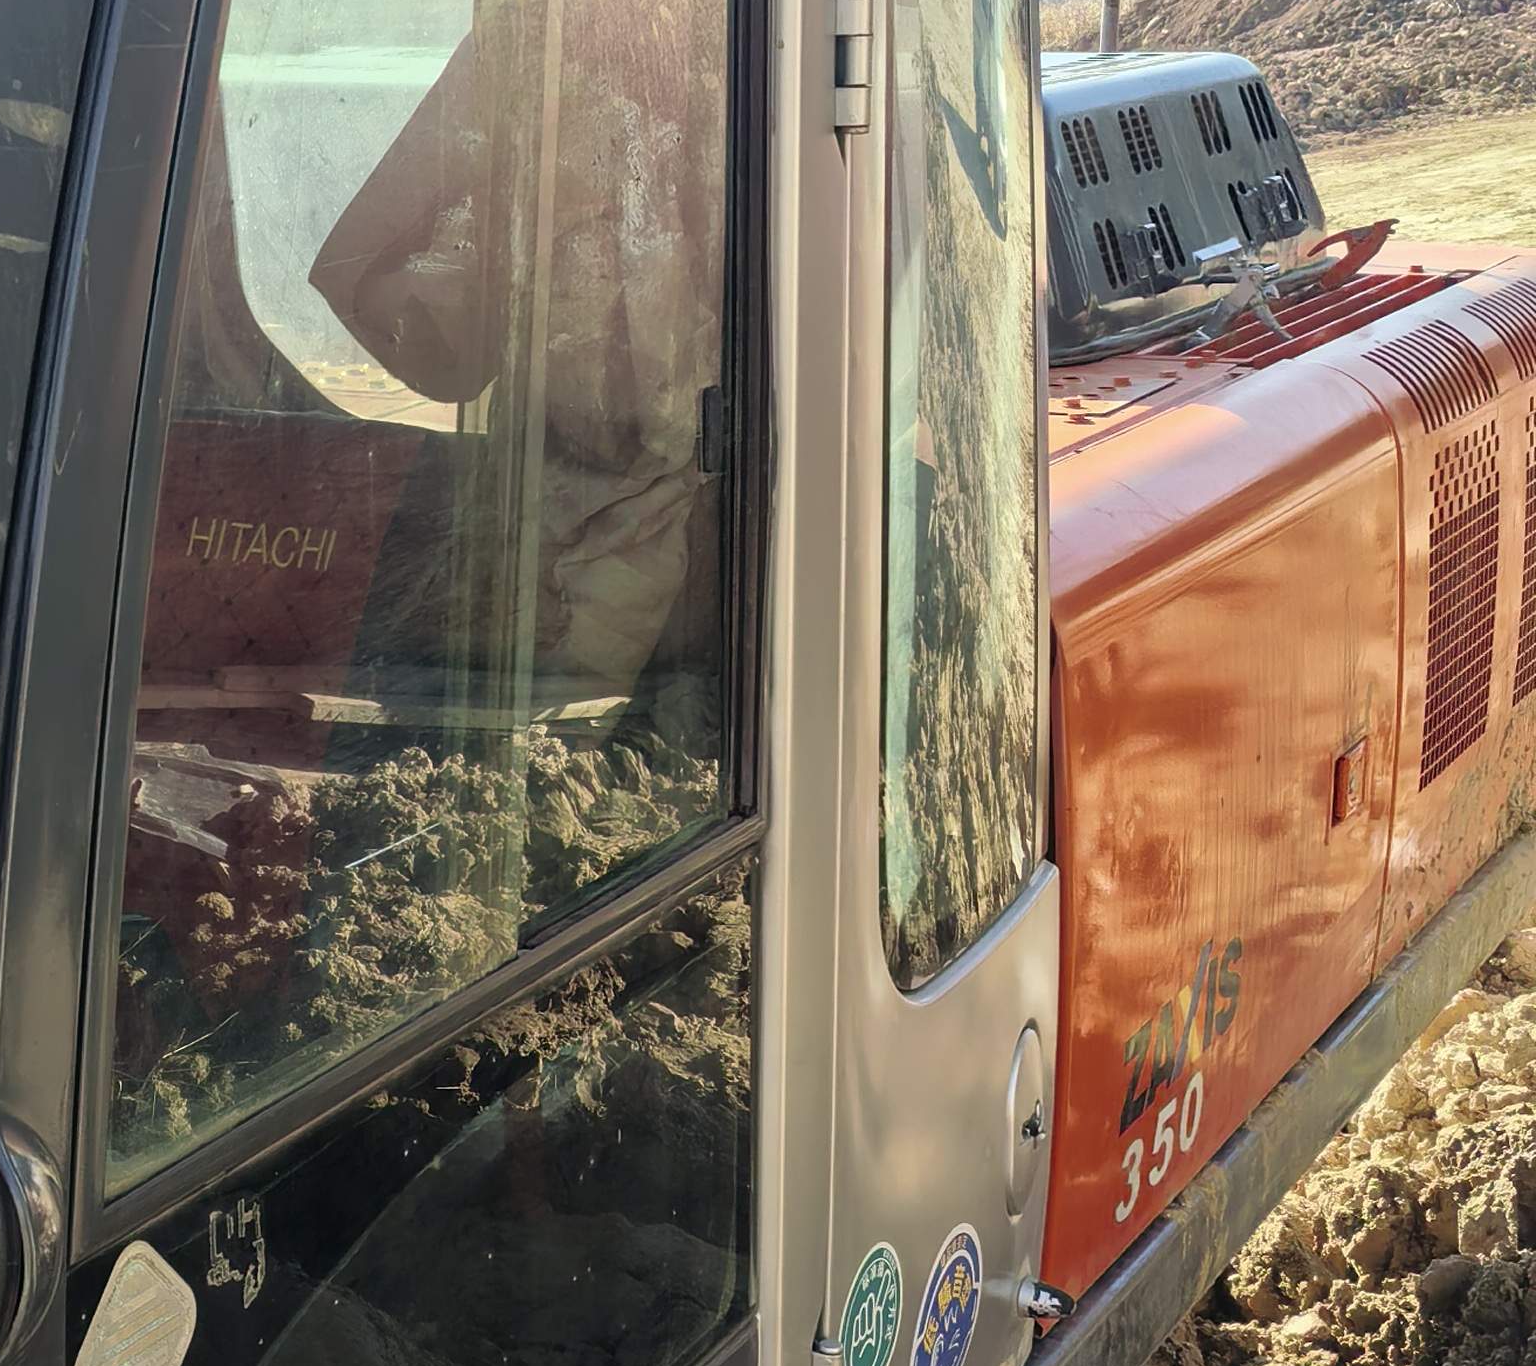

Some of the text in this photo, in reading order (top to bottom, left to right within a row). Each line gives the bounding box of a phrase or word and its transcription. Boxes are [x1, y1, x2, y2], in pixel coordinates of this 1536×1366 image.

[185, 516, 337, 572] HITACHI
[1118, 935, 1243, 1137] ZAXIS
[1114, 1070, 1204, 1224] 350
